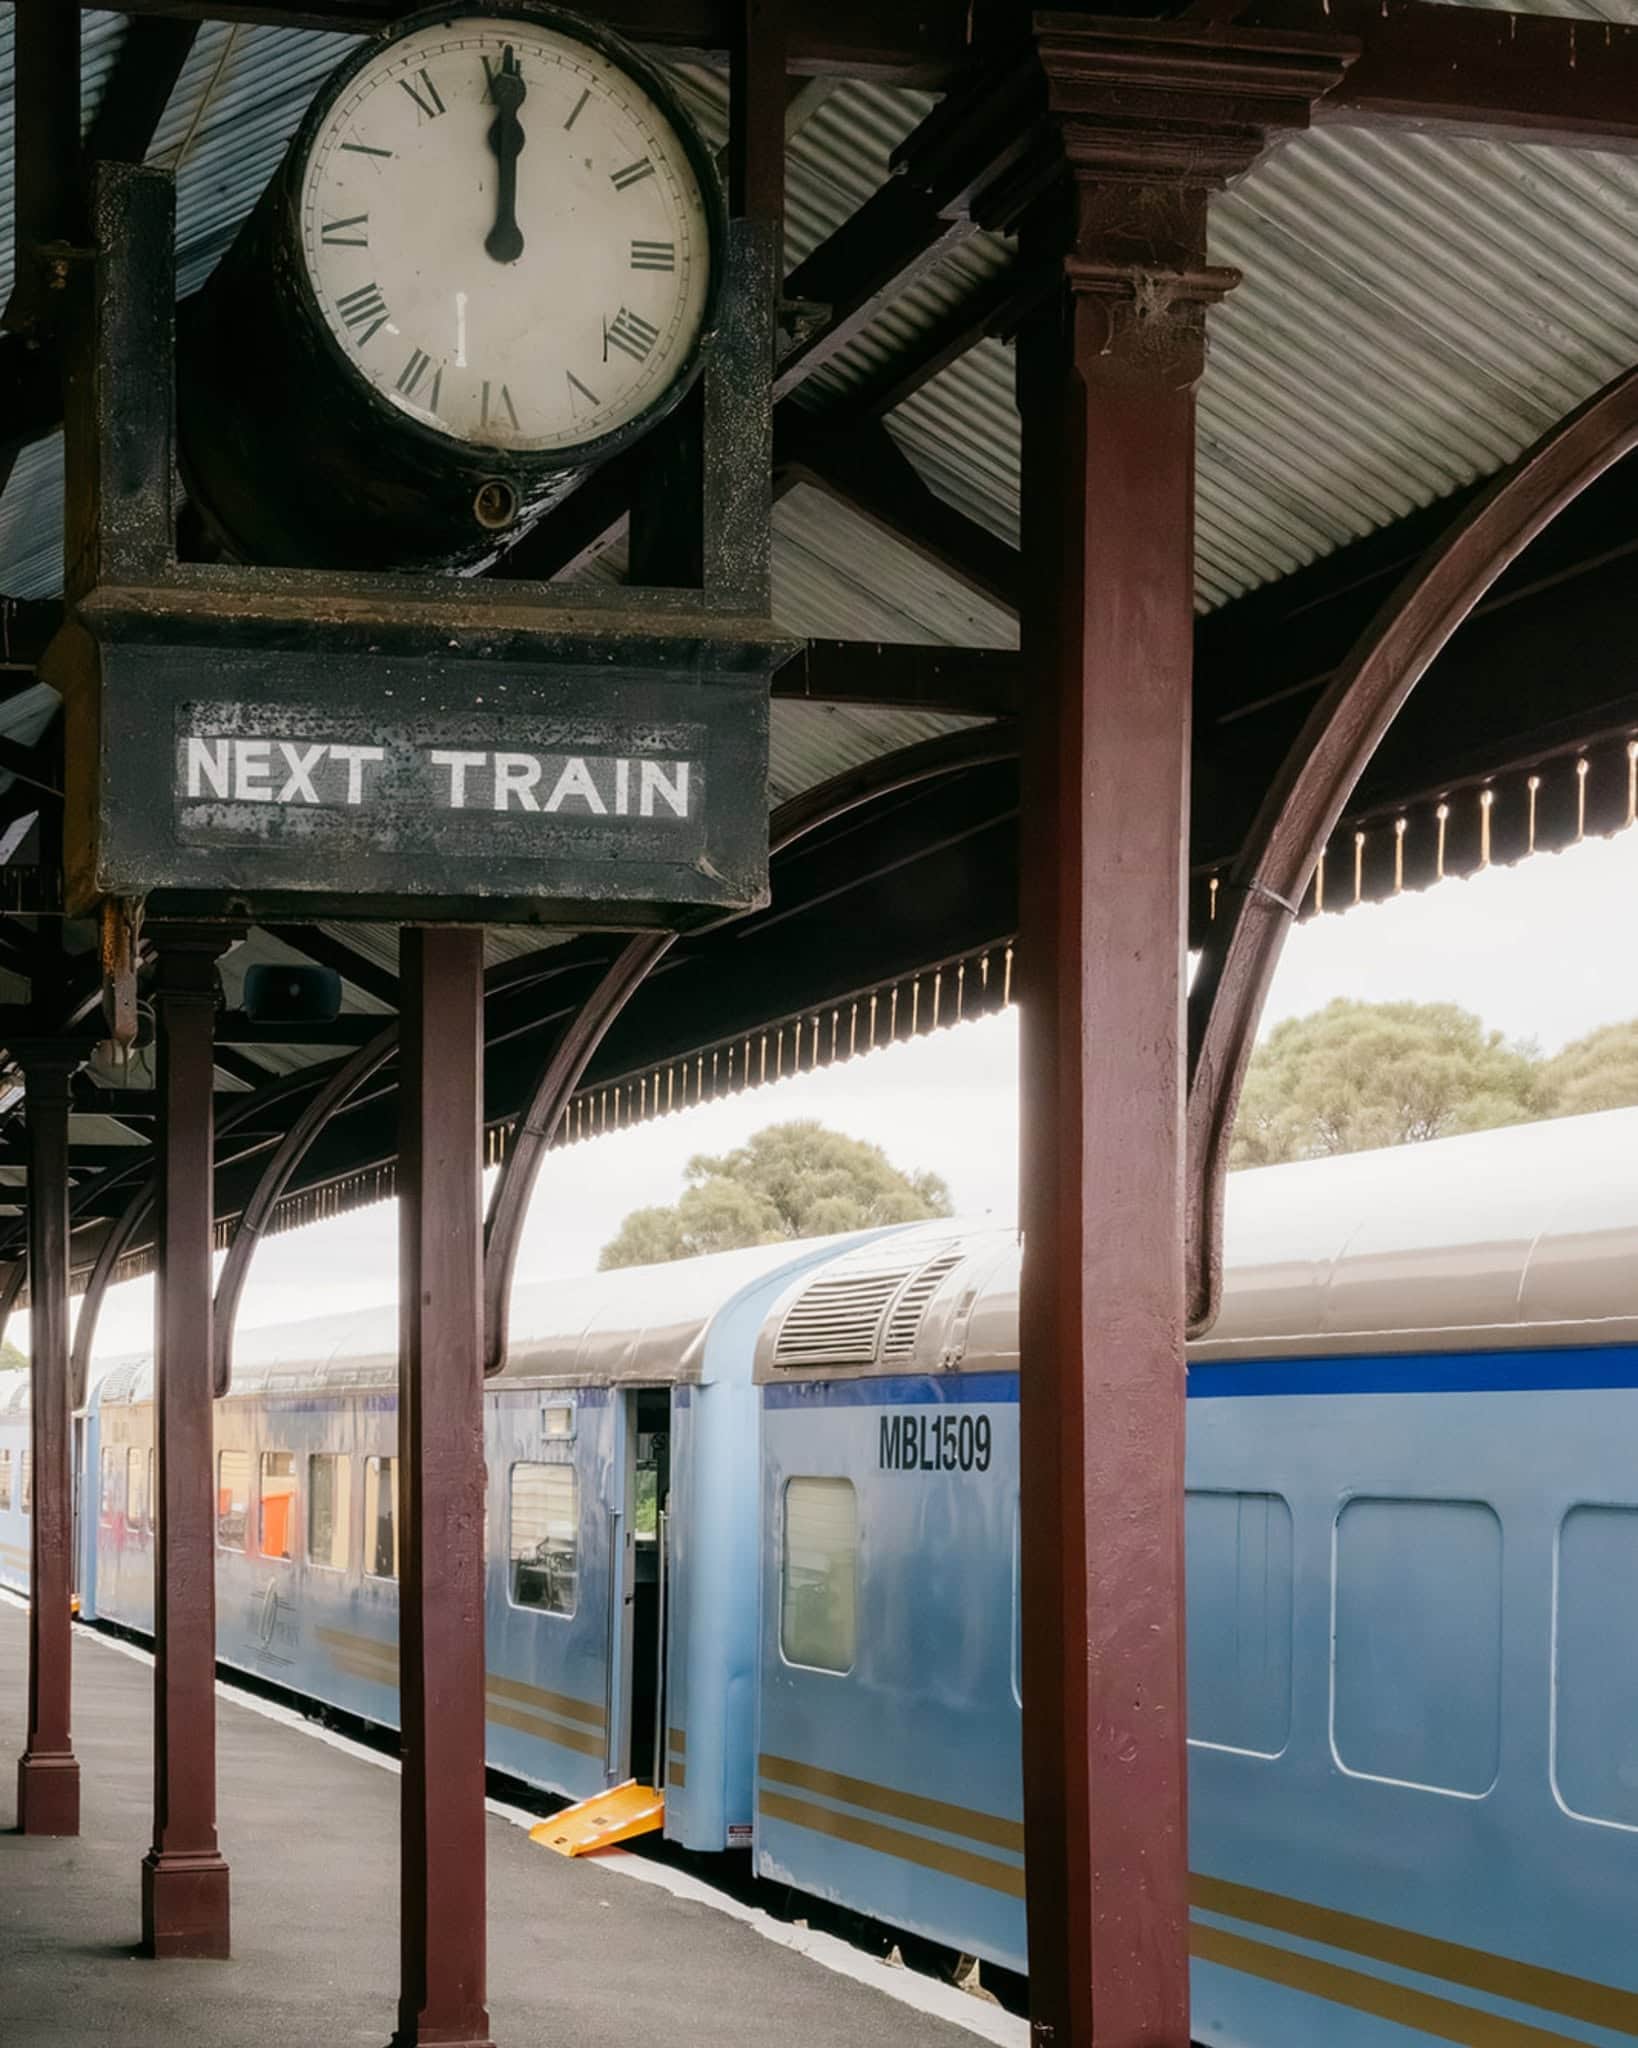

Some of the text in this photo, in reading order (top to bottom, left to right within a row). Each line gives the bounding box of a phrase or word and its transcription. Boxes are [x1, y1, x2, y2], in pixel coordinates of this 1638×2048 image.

[610, 156, 655, 191] II
[630, 240, 675, 271] III
[336, 282, 390, 348] VIII
[396, 348, 442, 414] VII
[187, 737, 690, 818] NEXT TRAIN
[879, 1414, 992, 1472] MBL1509
